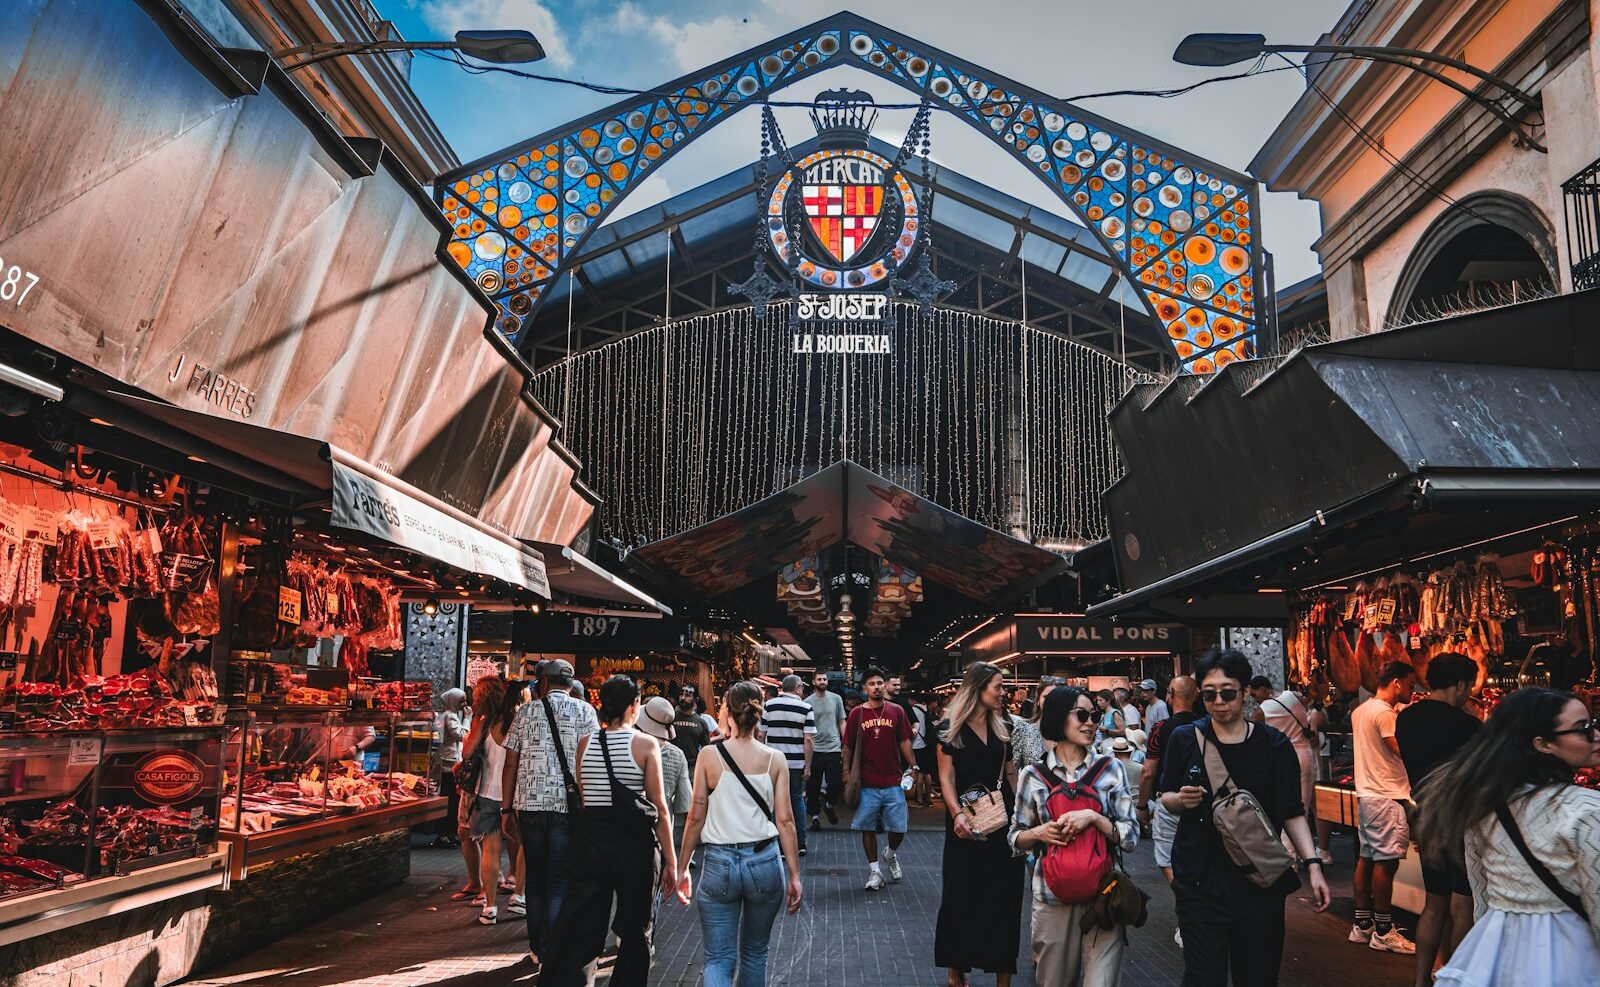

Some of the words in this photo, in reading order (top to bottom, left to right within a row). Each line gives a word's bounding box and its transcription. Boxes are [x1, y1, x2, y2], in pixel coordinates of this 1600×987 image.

[805, 158, 882, 184] MERCAT
[0, 256, 40, 306] 87
[818, 294, 887, 319] JOSEP
[793, 334, 812, 353] LA
[816, 334, 890, 353] BOQUERIA
[168, 354, 186, 383] J
[279, 600, 296, 619] 125
[571, 616, 620, 637] 1897
[1037, 626, 1102, 640] VIDAL
[1113, 627, 1169, 640] PONS
[861, 718, 893, 731] PORTUGAL
[137, 773, 163, 781] CASA
